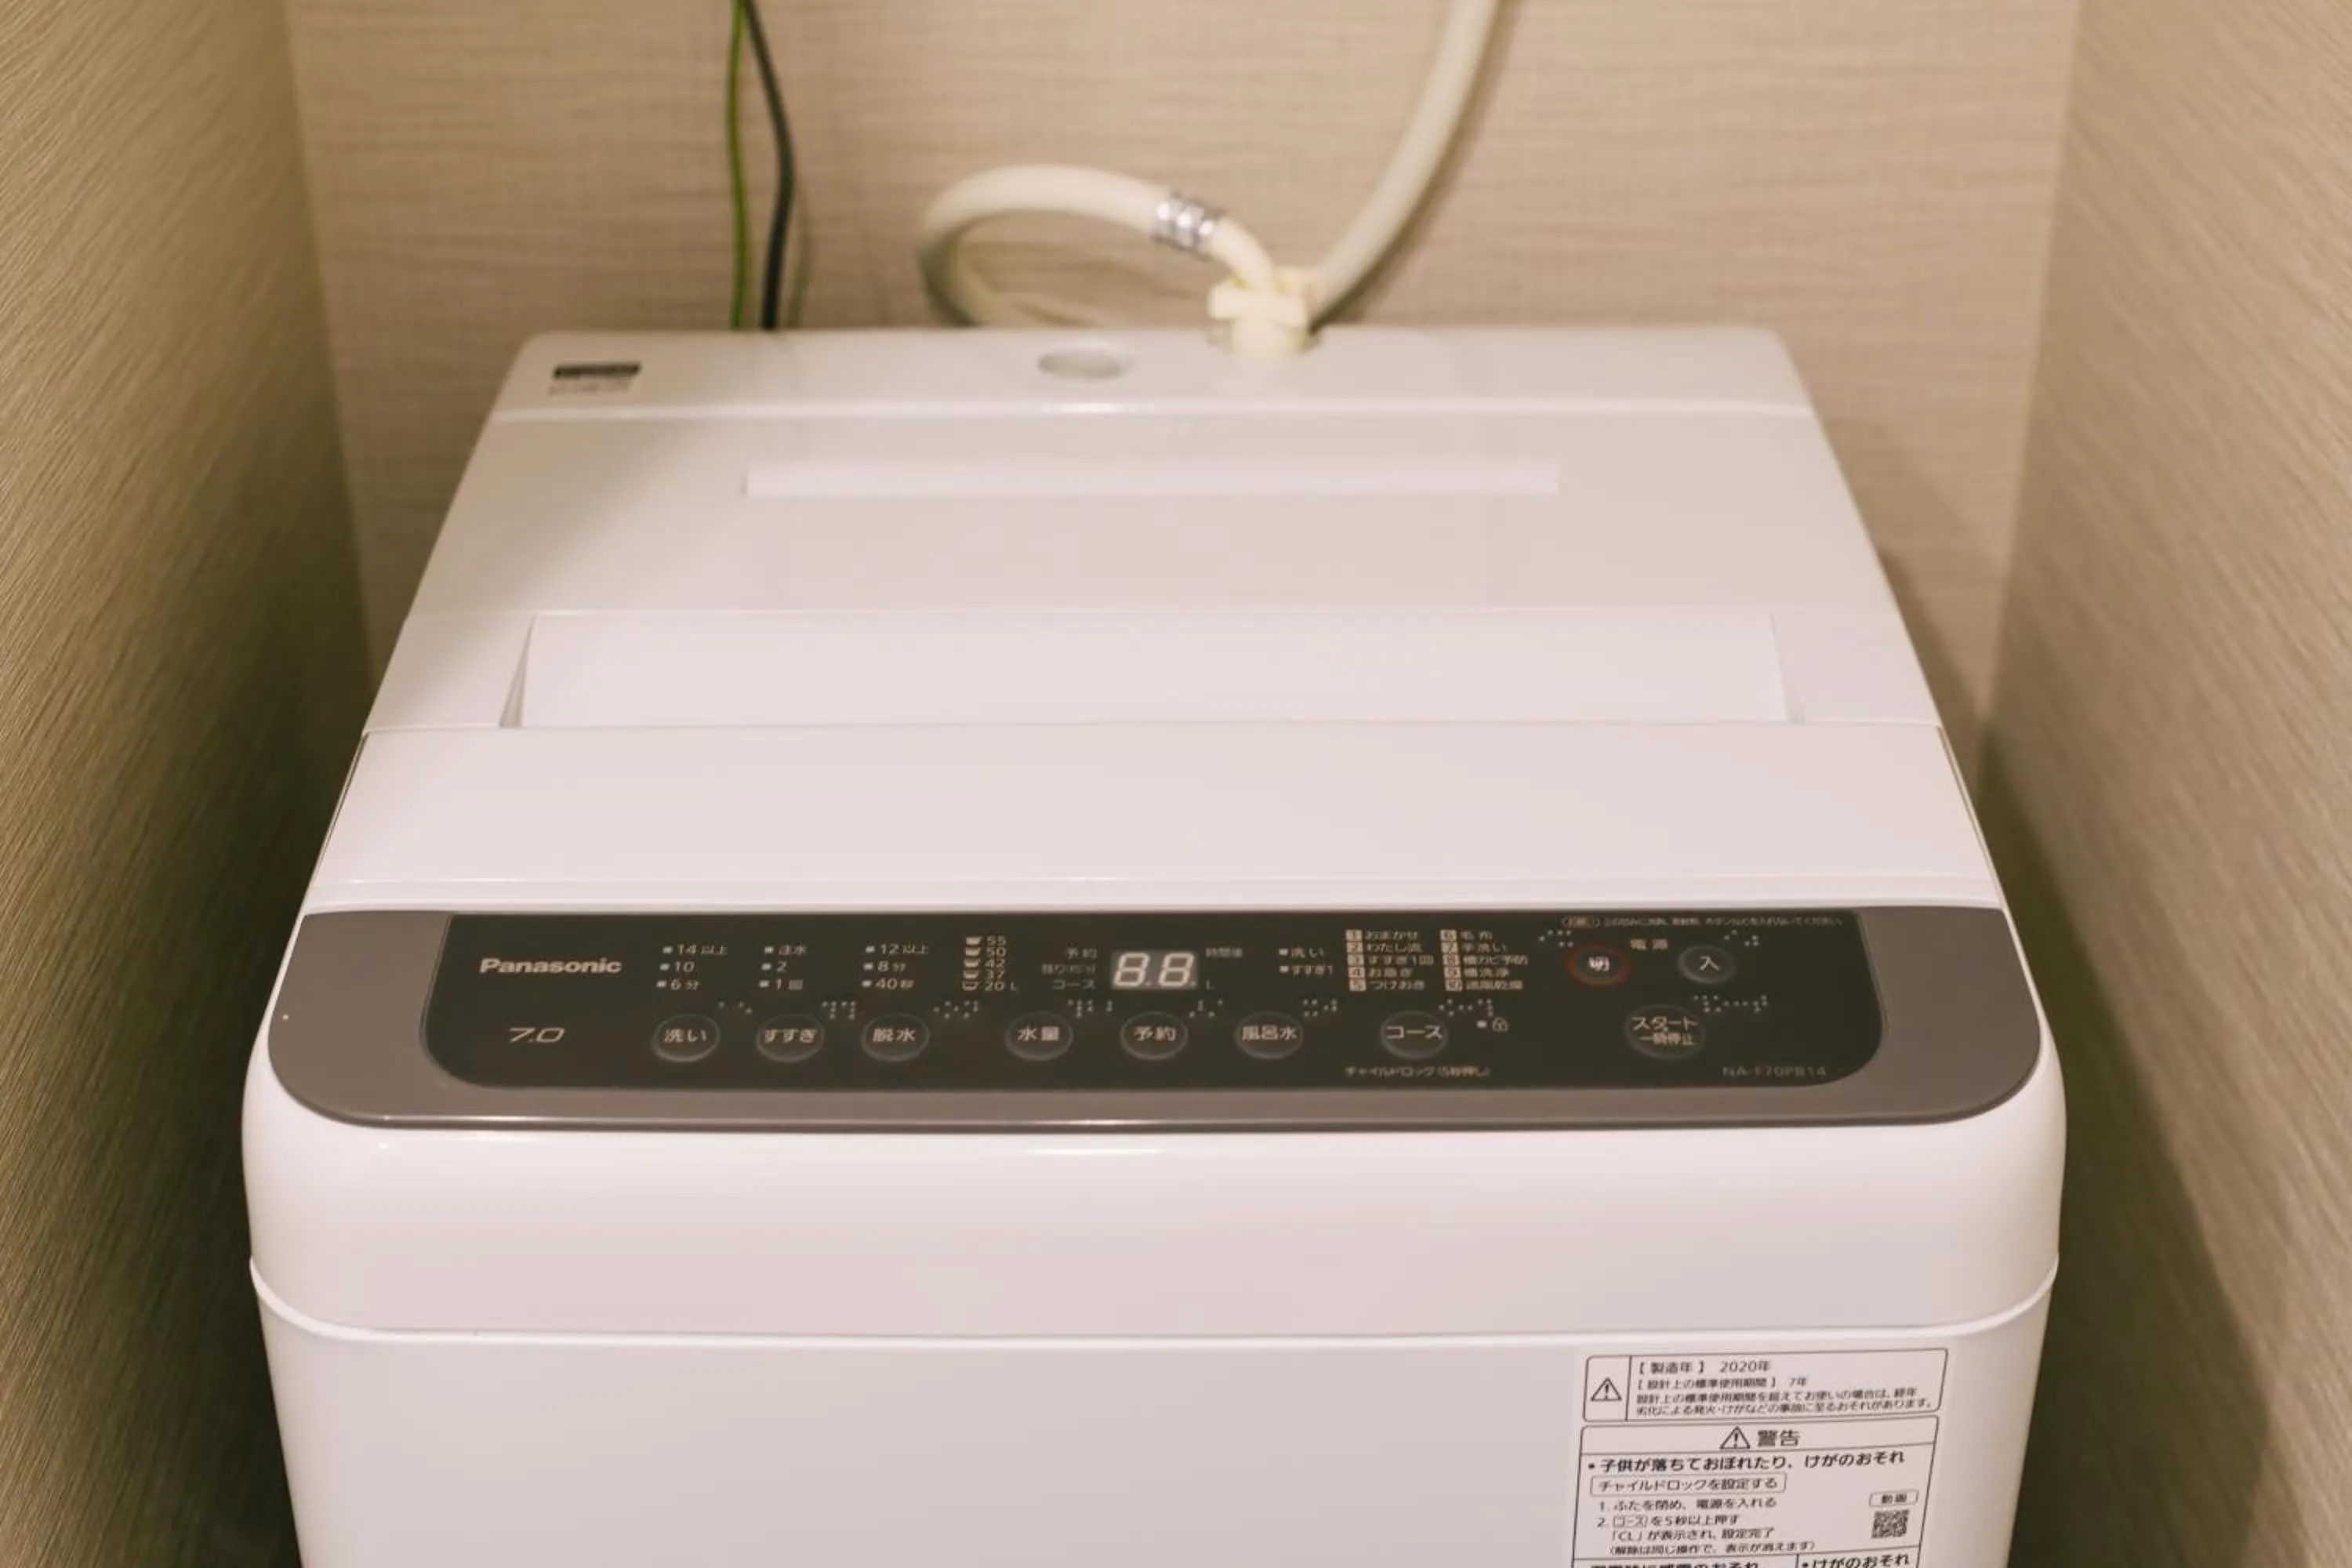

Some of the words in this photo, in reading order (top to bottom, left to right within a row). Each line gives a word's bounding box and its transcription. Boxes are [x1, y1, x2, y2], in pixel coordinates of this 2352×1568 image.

[677, 944, 697, 954] 14
[880, 944, 898, 955] 12
[985, 947, 1007, 957] 50
[479, 956, 622, 974] Panasonic
[674, 960, 695, 972] 10
[775, 960, 787, 972] 2
[877, 961, 888, 972] 8
[985, 958, 1005, 968] 42
[1700, 956, 1720, 971] 入
[985, 969, 1004, 979] 37
[670, 979, 681, 990] 6
[775, 978, 782, 989] 1
[876, 978, 898, 990] 40
[985, 981, 1004, 991] 20
[1010, 981, 1018, 991] L
[1052, 978, 1097, 990] コース
[1632, 1016, 1698, 1030] スタート
[509, 1027, 565, 1043] 7.0
[664, 1029, 707, 1043] 洗い
[764, 1029, 817, 1044] すすぎ
[873, 1028, 916, 1043] 脱水
[1134, 1026, 1176, 1041] 予約
[1242, 1025, 1298, 1040] 風呂水
[1386, 1025, 1443, 1041] コース
[1719, 1360, 1771, 1373] 2020年
[1790, 1377, 1807, 1387] 7年
[1757, 1429, 1800, 1447] 警告
[1599, 1477, 1777, 1492] チャイルドロックを設定する
